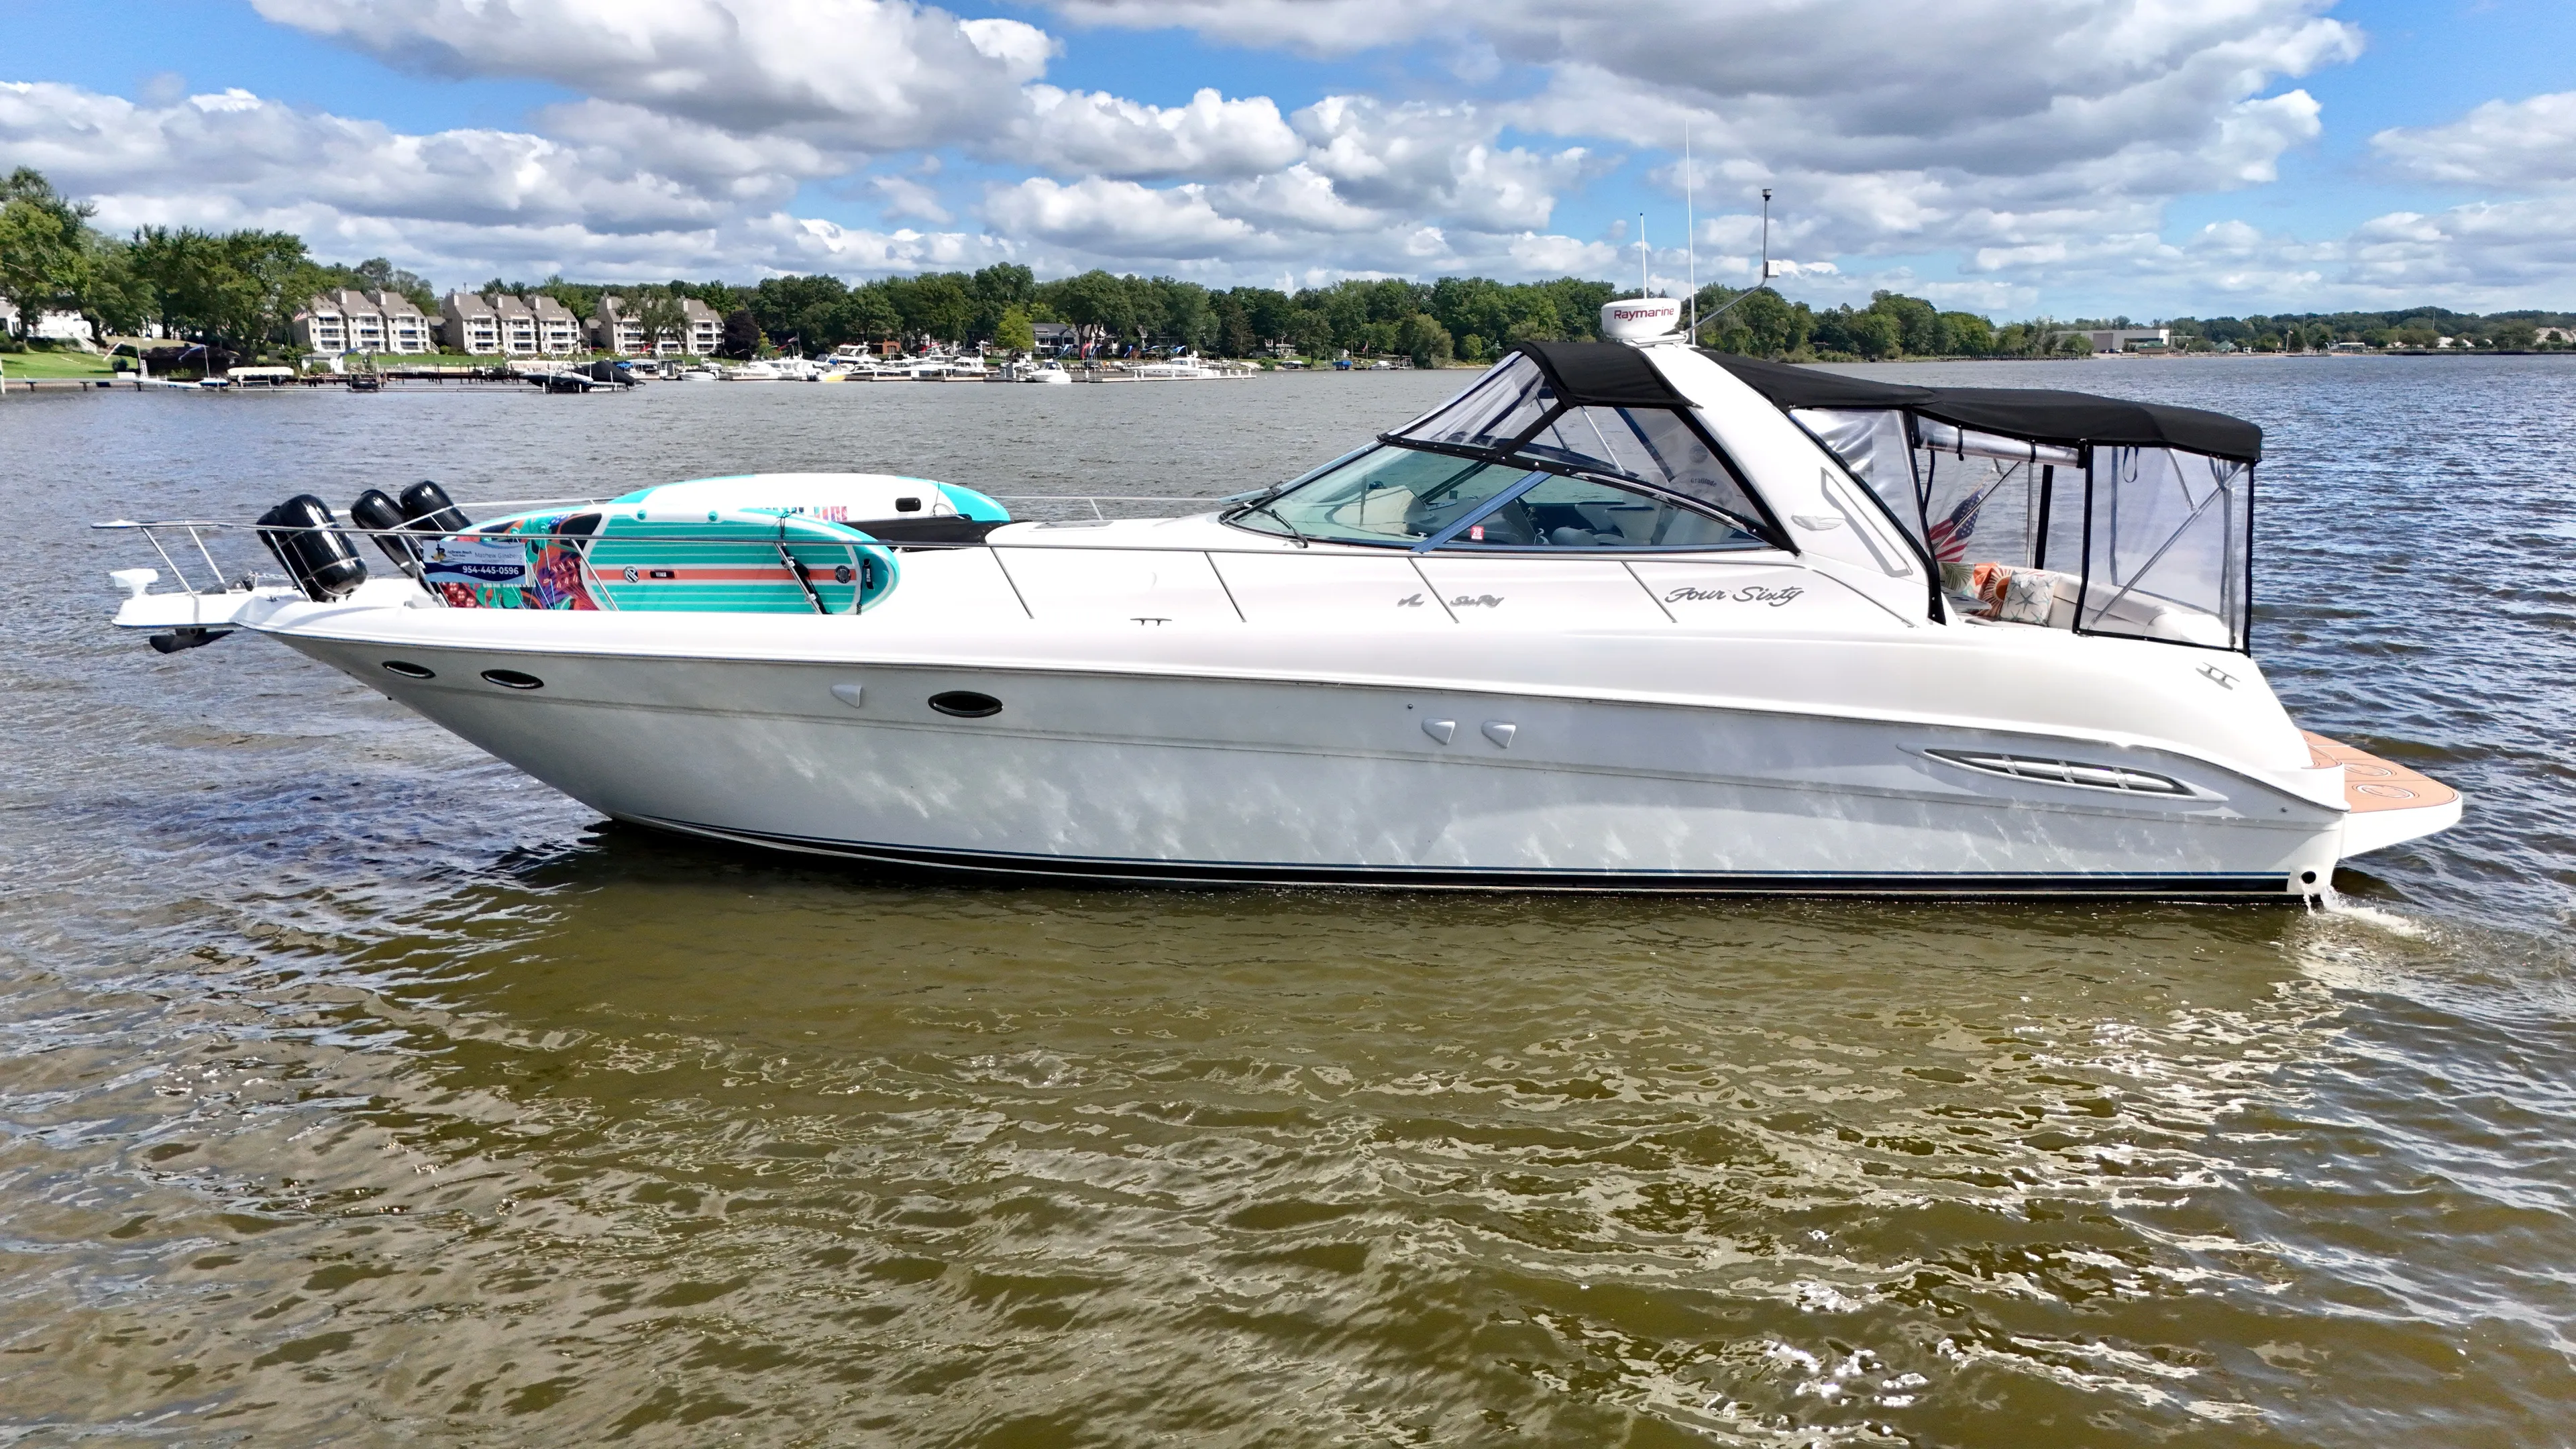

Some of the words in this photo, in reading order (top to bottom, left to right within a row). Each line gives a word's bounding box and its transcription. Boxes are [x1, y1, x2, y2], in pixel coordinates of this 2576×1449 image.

[1613, 307, 1674, 321] Raymarine
[1690, 477, 1717, 488] Gratitude
[462, 565, 519, 575] 954-445-0596
[1664, 587, 1727, 602] Four
[1732, 586, 1805, 607] Sixty
